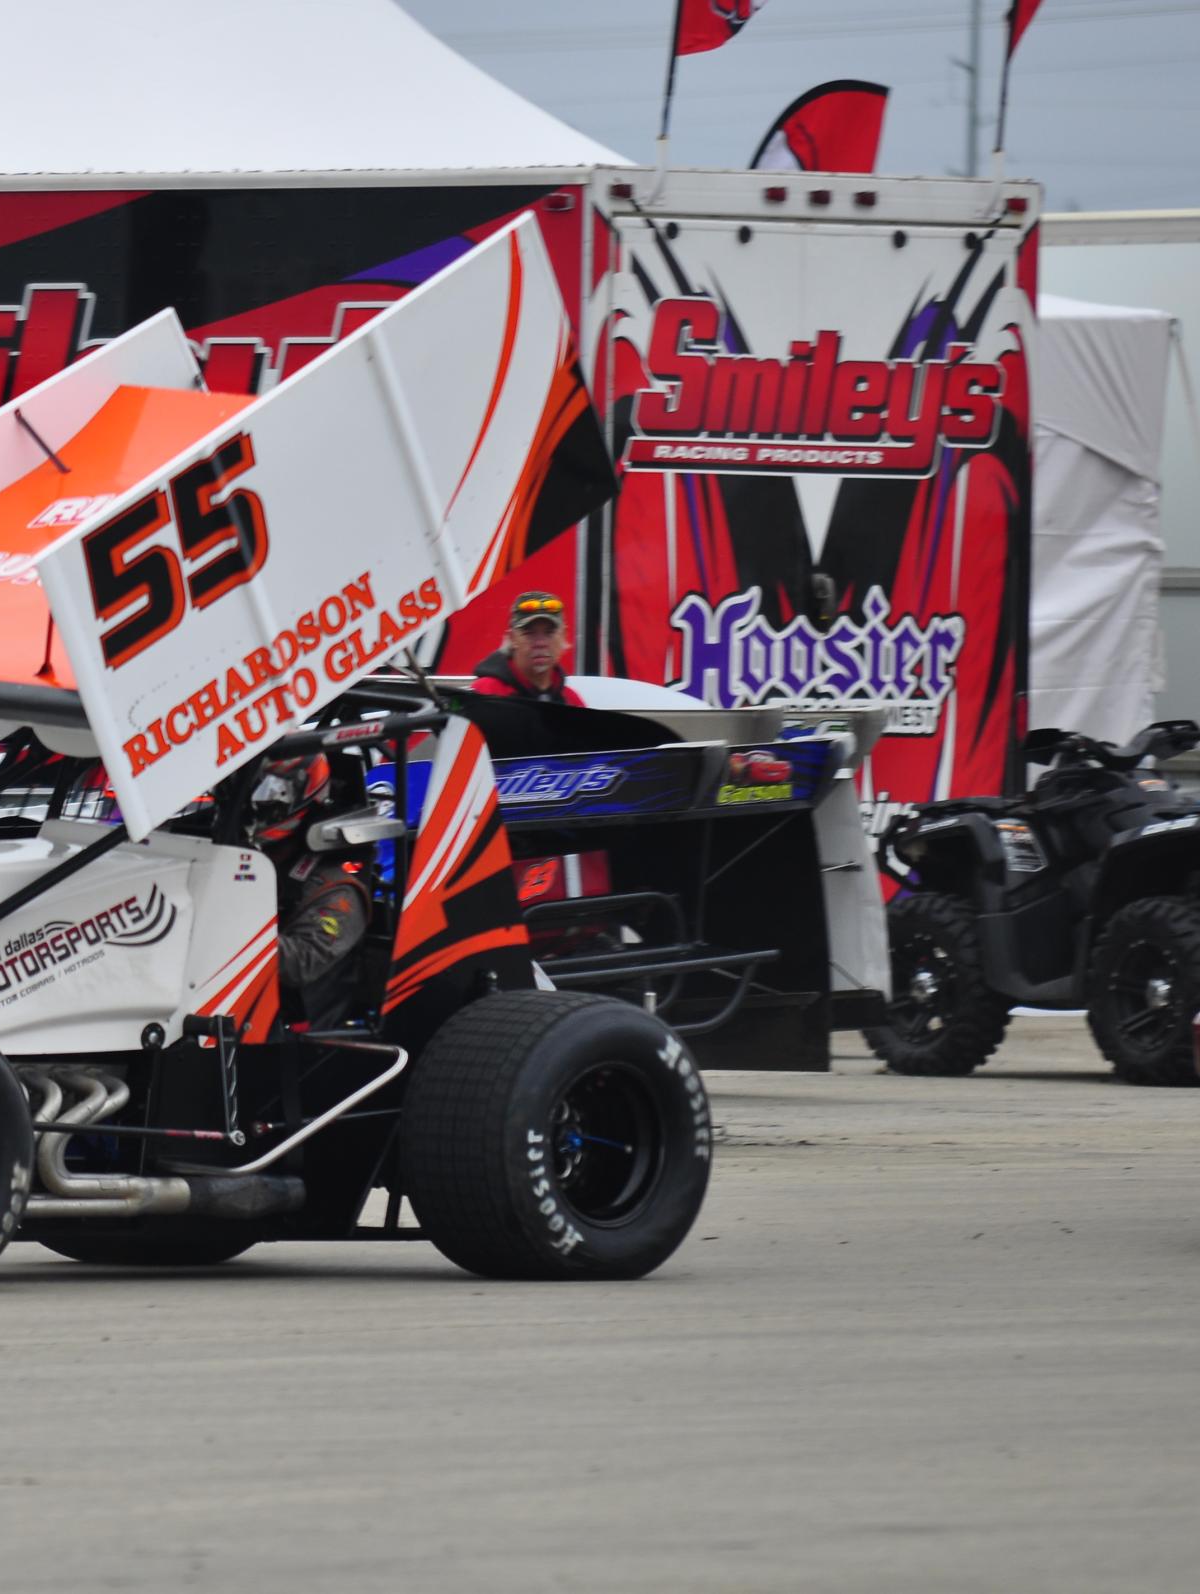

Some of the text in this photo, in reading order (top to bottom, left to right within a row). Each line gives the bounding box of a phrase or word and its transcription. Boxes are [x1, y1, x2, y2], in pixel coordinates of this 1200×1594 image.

[630, 294, 1005, 478] Smiley's
[653, 444, 884, 466] RACING PRODUCTS
[81, 431, 270, 672] 55
[121, 570, 379, 778] RICHARDSON
[215, 576, 444, 768] AUTO GLASS
[670, 585, 966, 709] Hoosier
[4, 927, 46, 957] dallas
[526, 1128, 585, 1256] Hoosier
